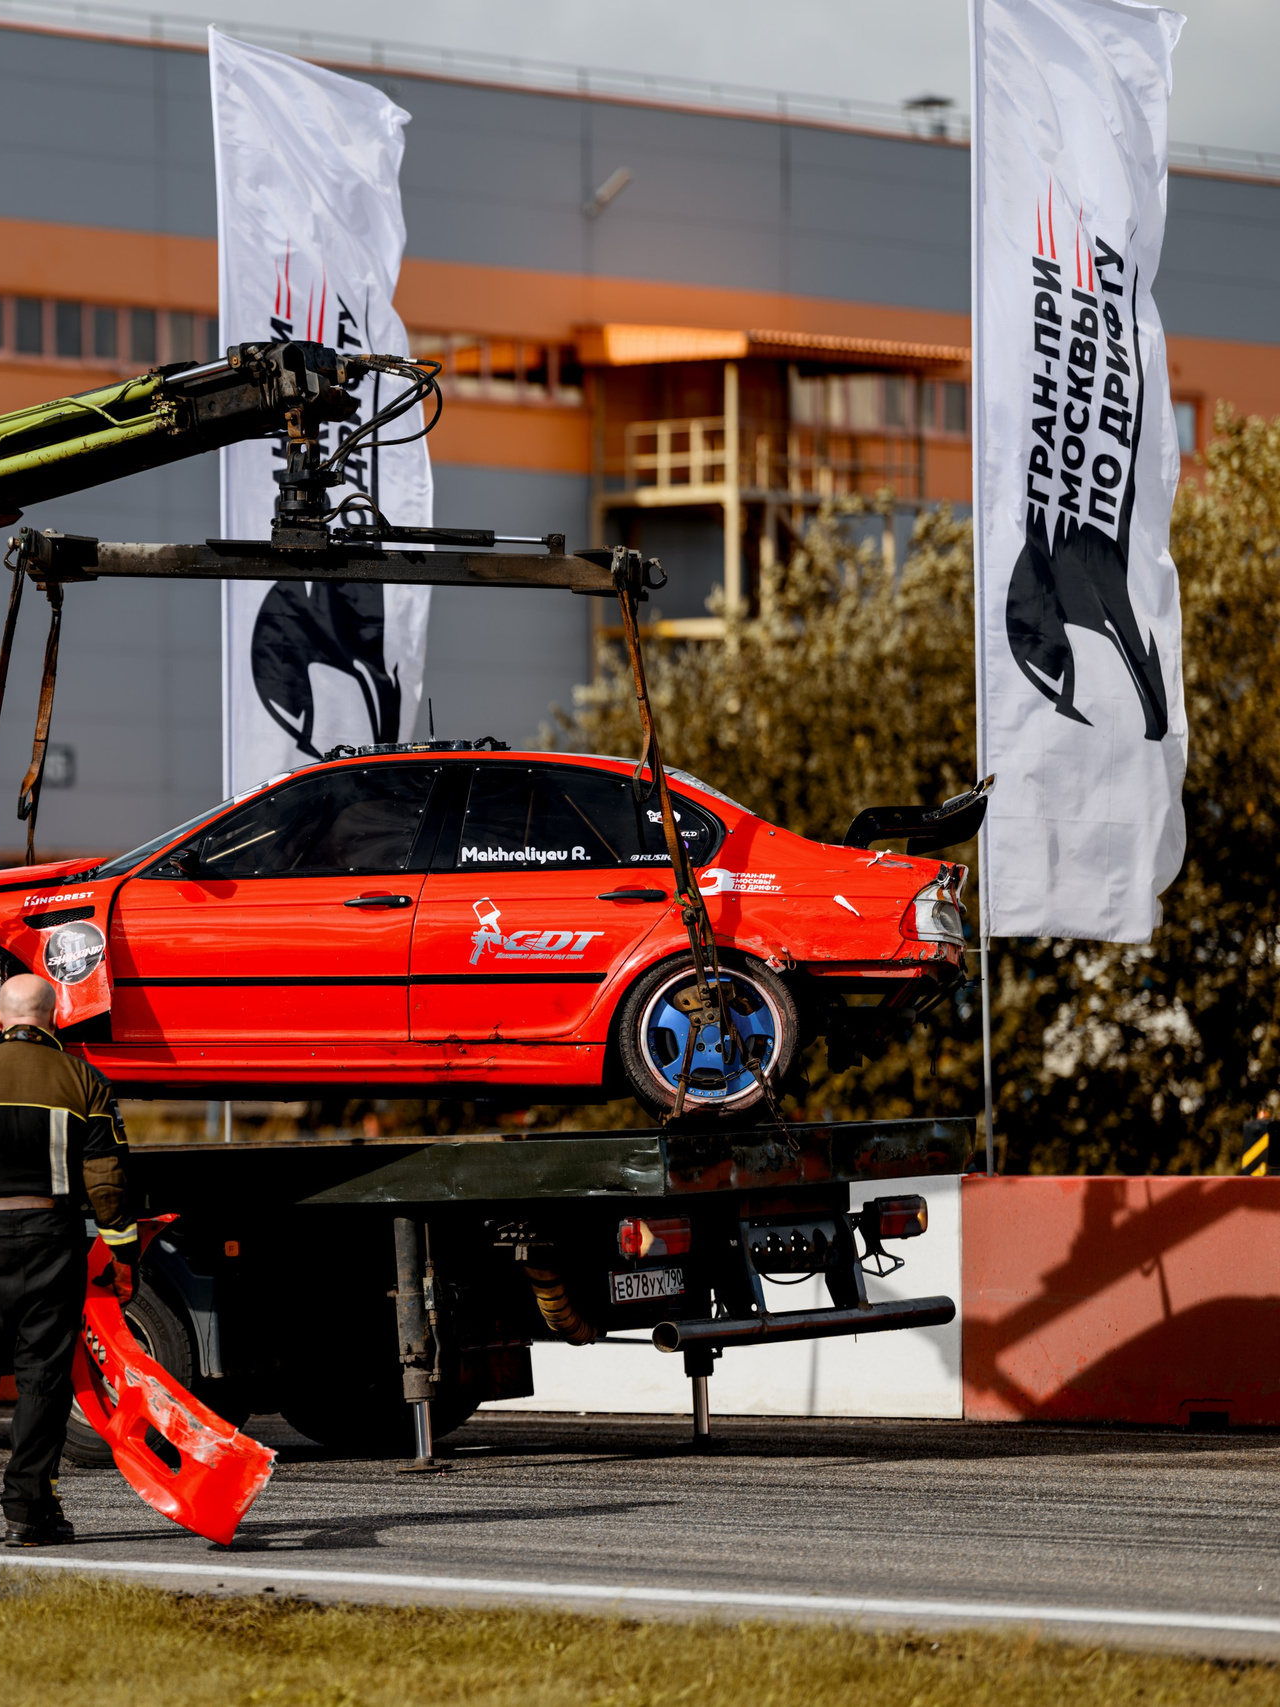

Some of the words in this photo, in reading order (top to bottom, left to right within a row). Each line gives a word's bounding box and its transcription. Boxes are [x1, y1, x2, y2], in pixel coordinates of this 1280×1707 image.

[1093, 235, 1133, 449] ДРИФТУ
[1026, 255, 1062, 507] ГРАН-ПРИ
[1058, 287, 1099, 515] МОСКВЫ
[1088, 453, 1123, 526] ПО
[571, 846, 592, 861] R.
[736, 872, 776, 880] ГРАН-ПРИ
[747, 884, 782, 892] ДРИФТУ
[616, 1273, 665, 1300] Е878УХ
[665, 1269, 682, 1288] 790
